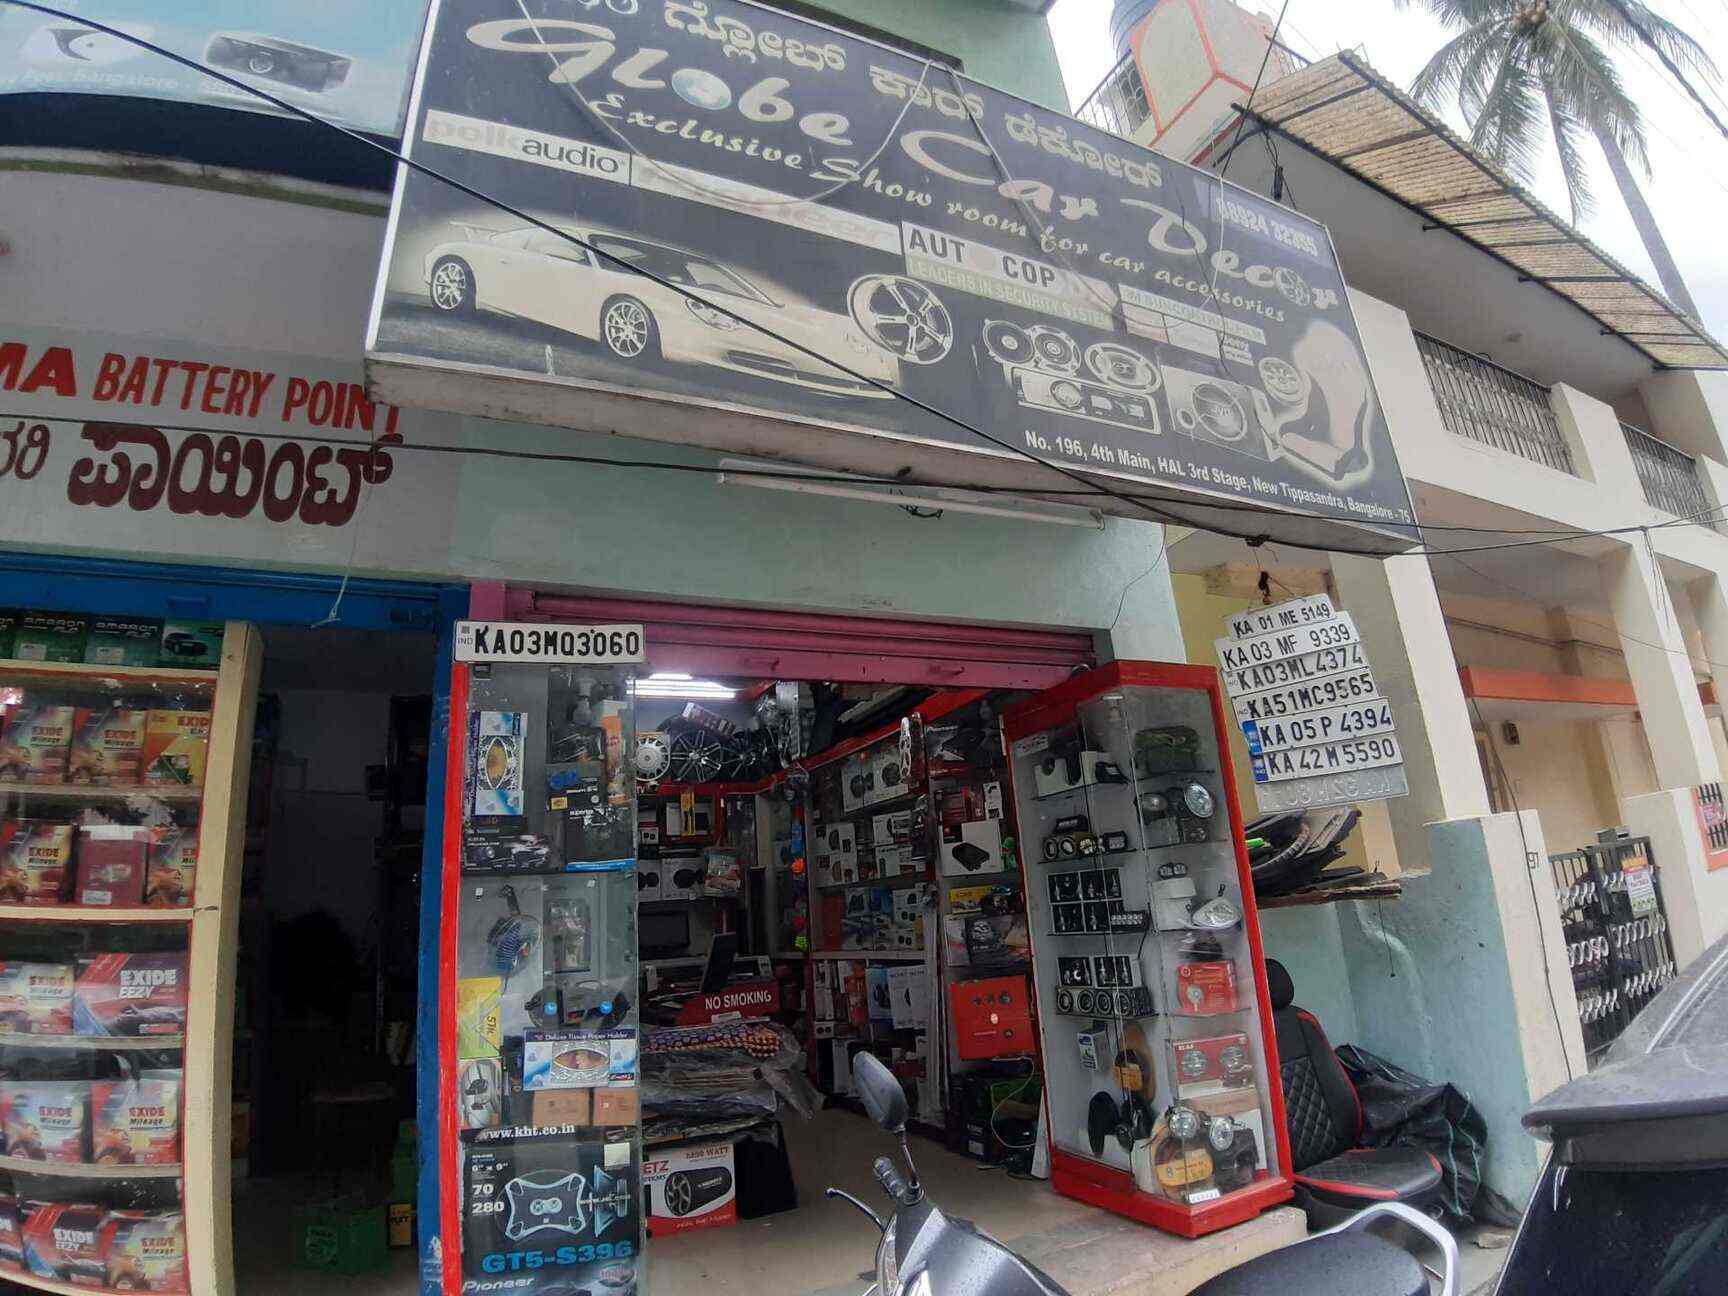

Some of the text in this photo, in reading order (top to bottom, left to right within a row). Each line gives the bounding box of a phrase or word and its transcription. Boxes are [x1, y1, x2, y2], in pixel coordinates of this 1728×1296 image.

[590, 94, 803, 169] Exclusive
[947, 202, 1026, 237] room
[1099, 252, 1145, 273] car
[901, 131, 1099, 220] Car
[1002, 255, 1057, 288] COP
[92, 352, 275, 419] BATTERY
[282, 374, 402, 434] POINT
[1025, 430, 1052, 451] No.
[1055, 438, 1088, 461] 196,
[1091, 444, 1115, 463] 4th
[1117, 448, 1156, 475] Main,
[1159, 456, 1186, 476] HAL
[1189, 463, 1210, 481] 3rd
[1213, 468, 1251, 492] Stage,
[1252, 476, 1279, 496] New
[1279, 482, 1349, 513] Tippasandra,
[1349, 496, 1393, 521] Bangalore
[1233, 602, 1331, 638] KA 01 ME 5149
[475, 626, 640, 657] KA03MQ3060
[1223, 623, 1351, 669] KA 03 MF 9339
[104, 730, 136, 739] EXIDE
[1261, 705, 1393, 747] KA 05 P 4394
[1269, 738, 1395, 776] KA 42 M 5590
[28, 848, 60, 858] EXIDE
[120, 969, 177, 986] EXIDE
[705, 990, 772, 1010] NO SMOKING
[129, 1106, 165, 1118] EXIDE
[472, 1183, 495, 1196] 70
[472, 1200, 505, 1214] 280
[54, 1228, 94, 1244] EXIDE
[463, 1277, 535, 1293] Pioneer
